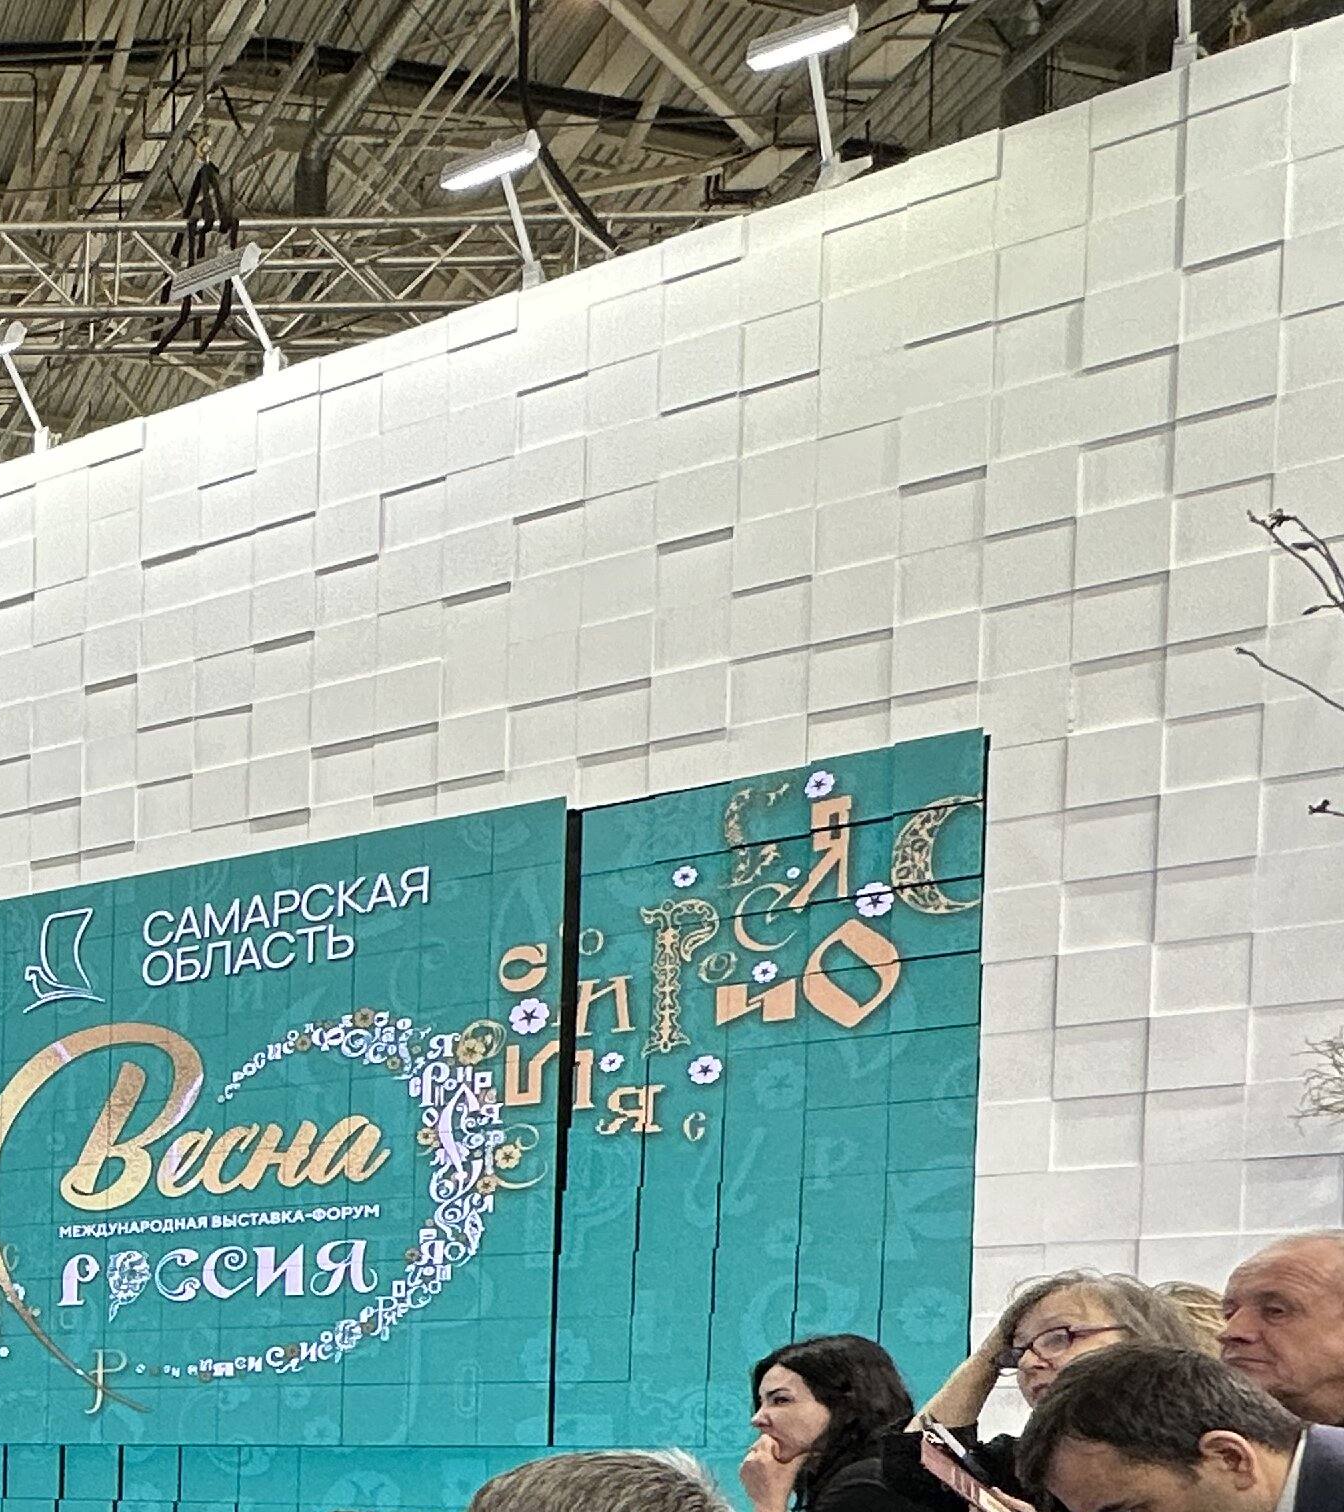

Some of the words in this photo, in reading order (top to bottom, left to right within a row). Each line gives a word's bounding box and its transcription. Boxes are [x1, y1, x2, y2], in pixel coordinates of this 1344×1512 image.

[141, 866, 433, 948] САМАРСКАЯ
[141, 923, 356, 987] ОБЛАСТЬ
[58, 1215, 208, 1238] МЕЖДУНАРОДНАЯ
[211, 1203, 381, 1229] ВЫСТАВКА-ФОРУМ
[57, 1239, 379, 1323] РОССИЯ
